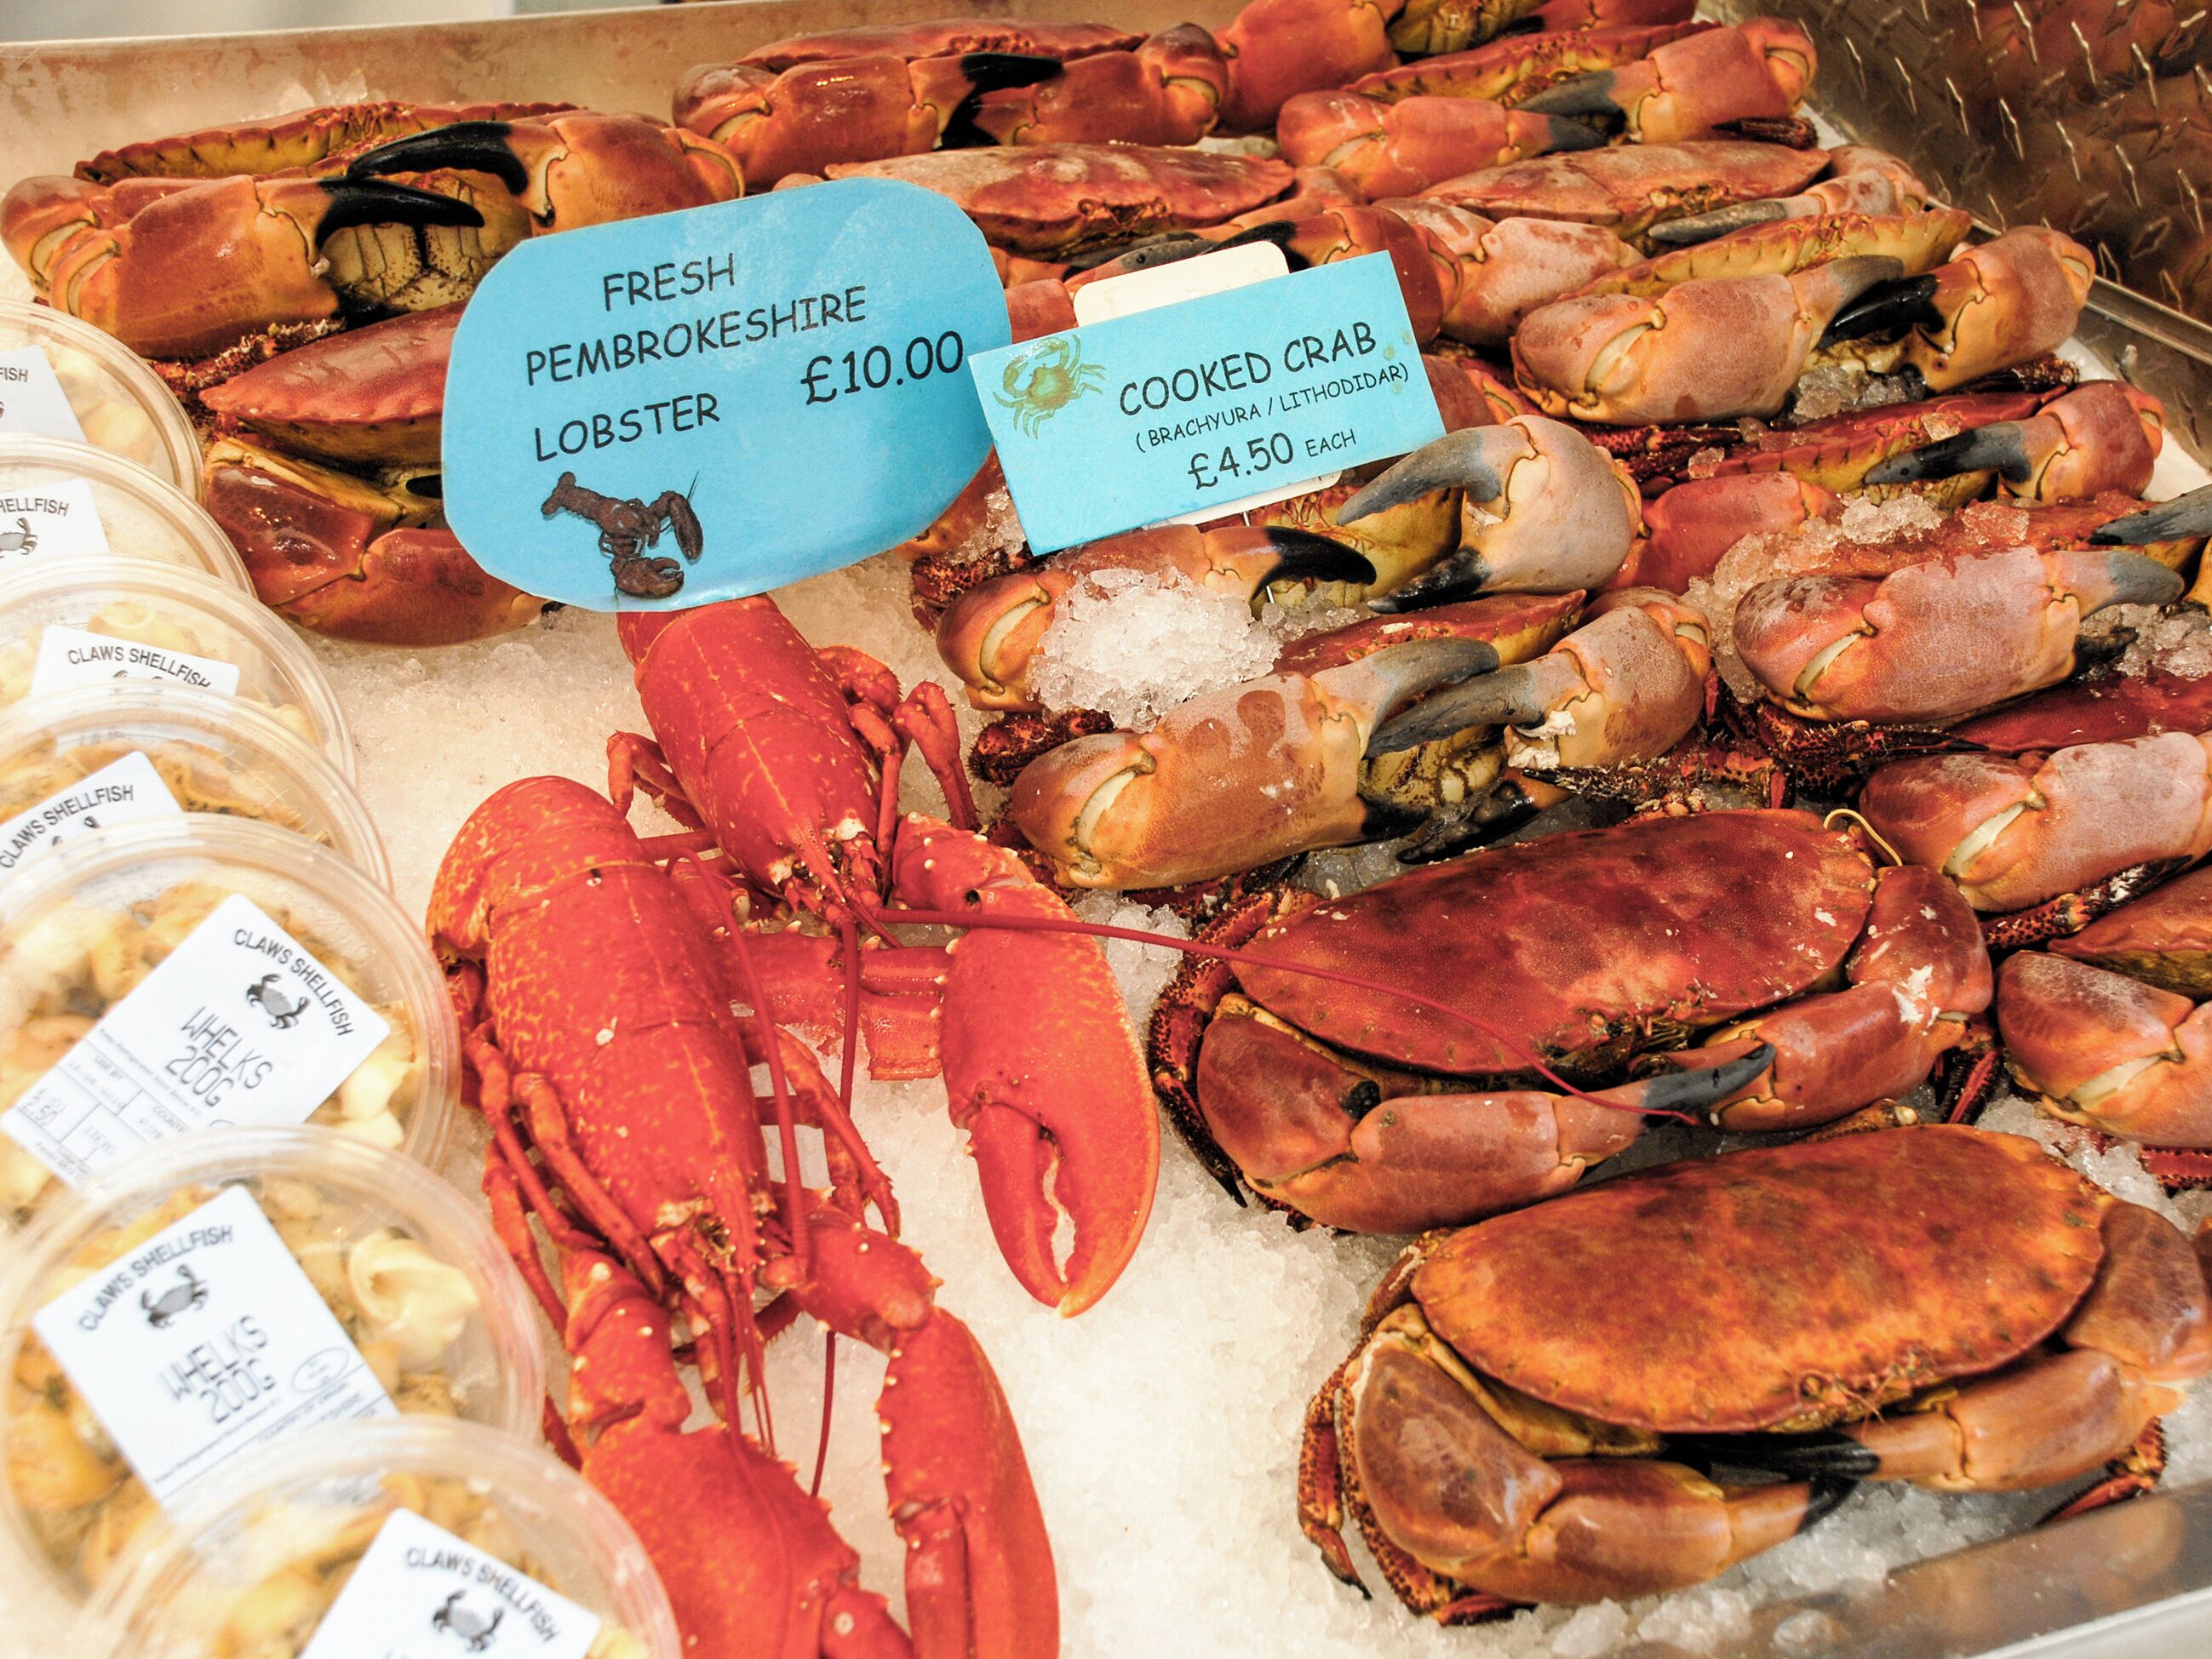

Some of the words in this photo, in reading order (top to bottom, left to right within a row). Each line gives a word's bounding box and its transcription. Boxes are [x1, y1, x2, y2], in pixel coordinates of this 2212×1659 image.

[604, 253, 735, 312] FRESH
[525, 286, 866, 386] PEMBROKESHIRE
[799, 330, 965, 406] £10.00
[1120, 352, 1272, 415] COOKED
[1284, 322, 1377, 373] CRAB
[534, 393, 721, 462] LOBSTER
[1188, 432, 1294, 490] £4.50
[1304, 429, 1357, 458] EACH
[68, 645, 124, 665] CLAWS
[0, 820, 46, 868] CLAWS
[43, 785, 134, 826] SHELLFISH
[234, 929, 293, 964] CLAWS
[290, 958, 354, 1036] SHELLFISH
[166, 1045, 234, 1107] 200G
[181, 1006, 272, 1090] WHELKS
[79, 1272, 133, 1330] CLAWS
[131, 1225, 232, 1278] SHELLFISH
[159, 1315, 268, 1402] WHELKS
[407, 1548, 474, 1576] CLAWS
[477, 1565, 560, 1642] SHELLFISH
